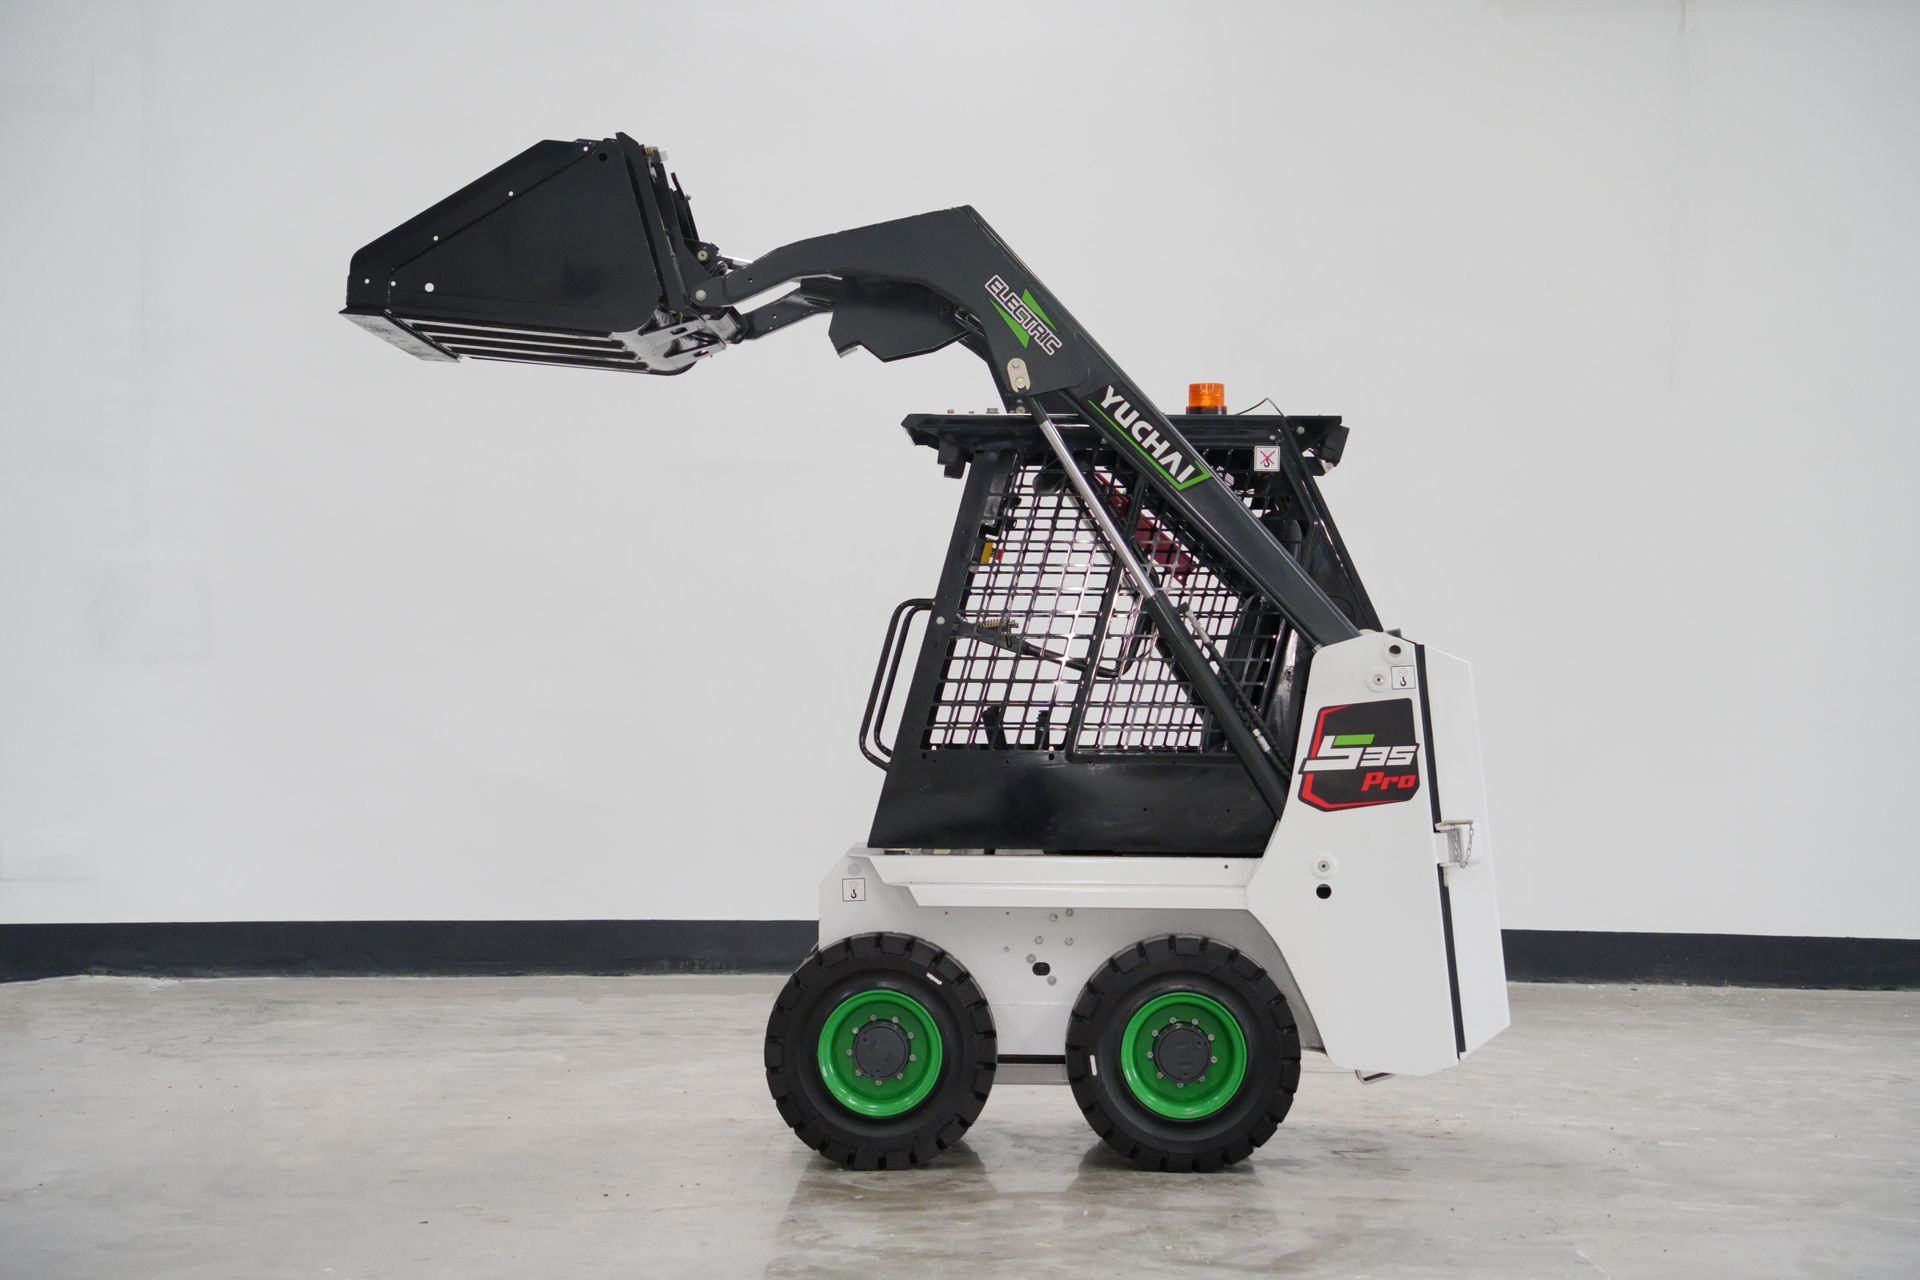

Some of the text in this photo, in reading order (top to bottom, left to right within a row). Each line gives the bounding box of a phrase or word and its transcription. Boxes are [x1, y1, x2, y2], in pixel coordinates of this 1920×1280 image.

[985, 275, 1062, 355] ELECTRIC
[1100, 385, 1195, 483] YUCHAI
[1303, 734, 1417, 771] S35
[1361, 771, 1416, 792] Pro
